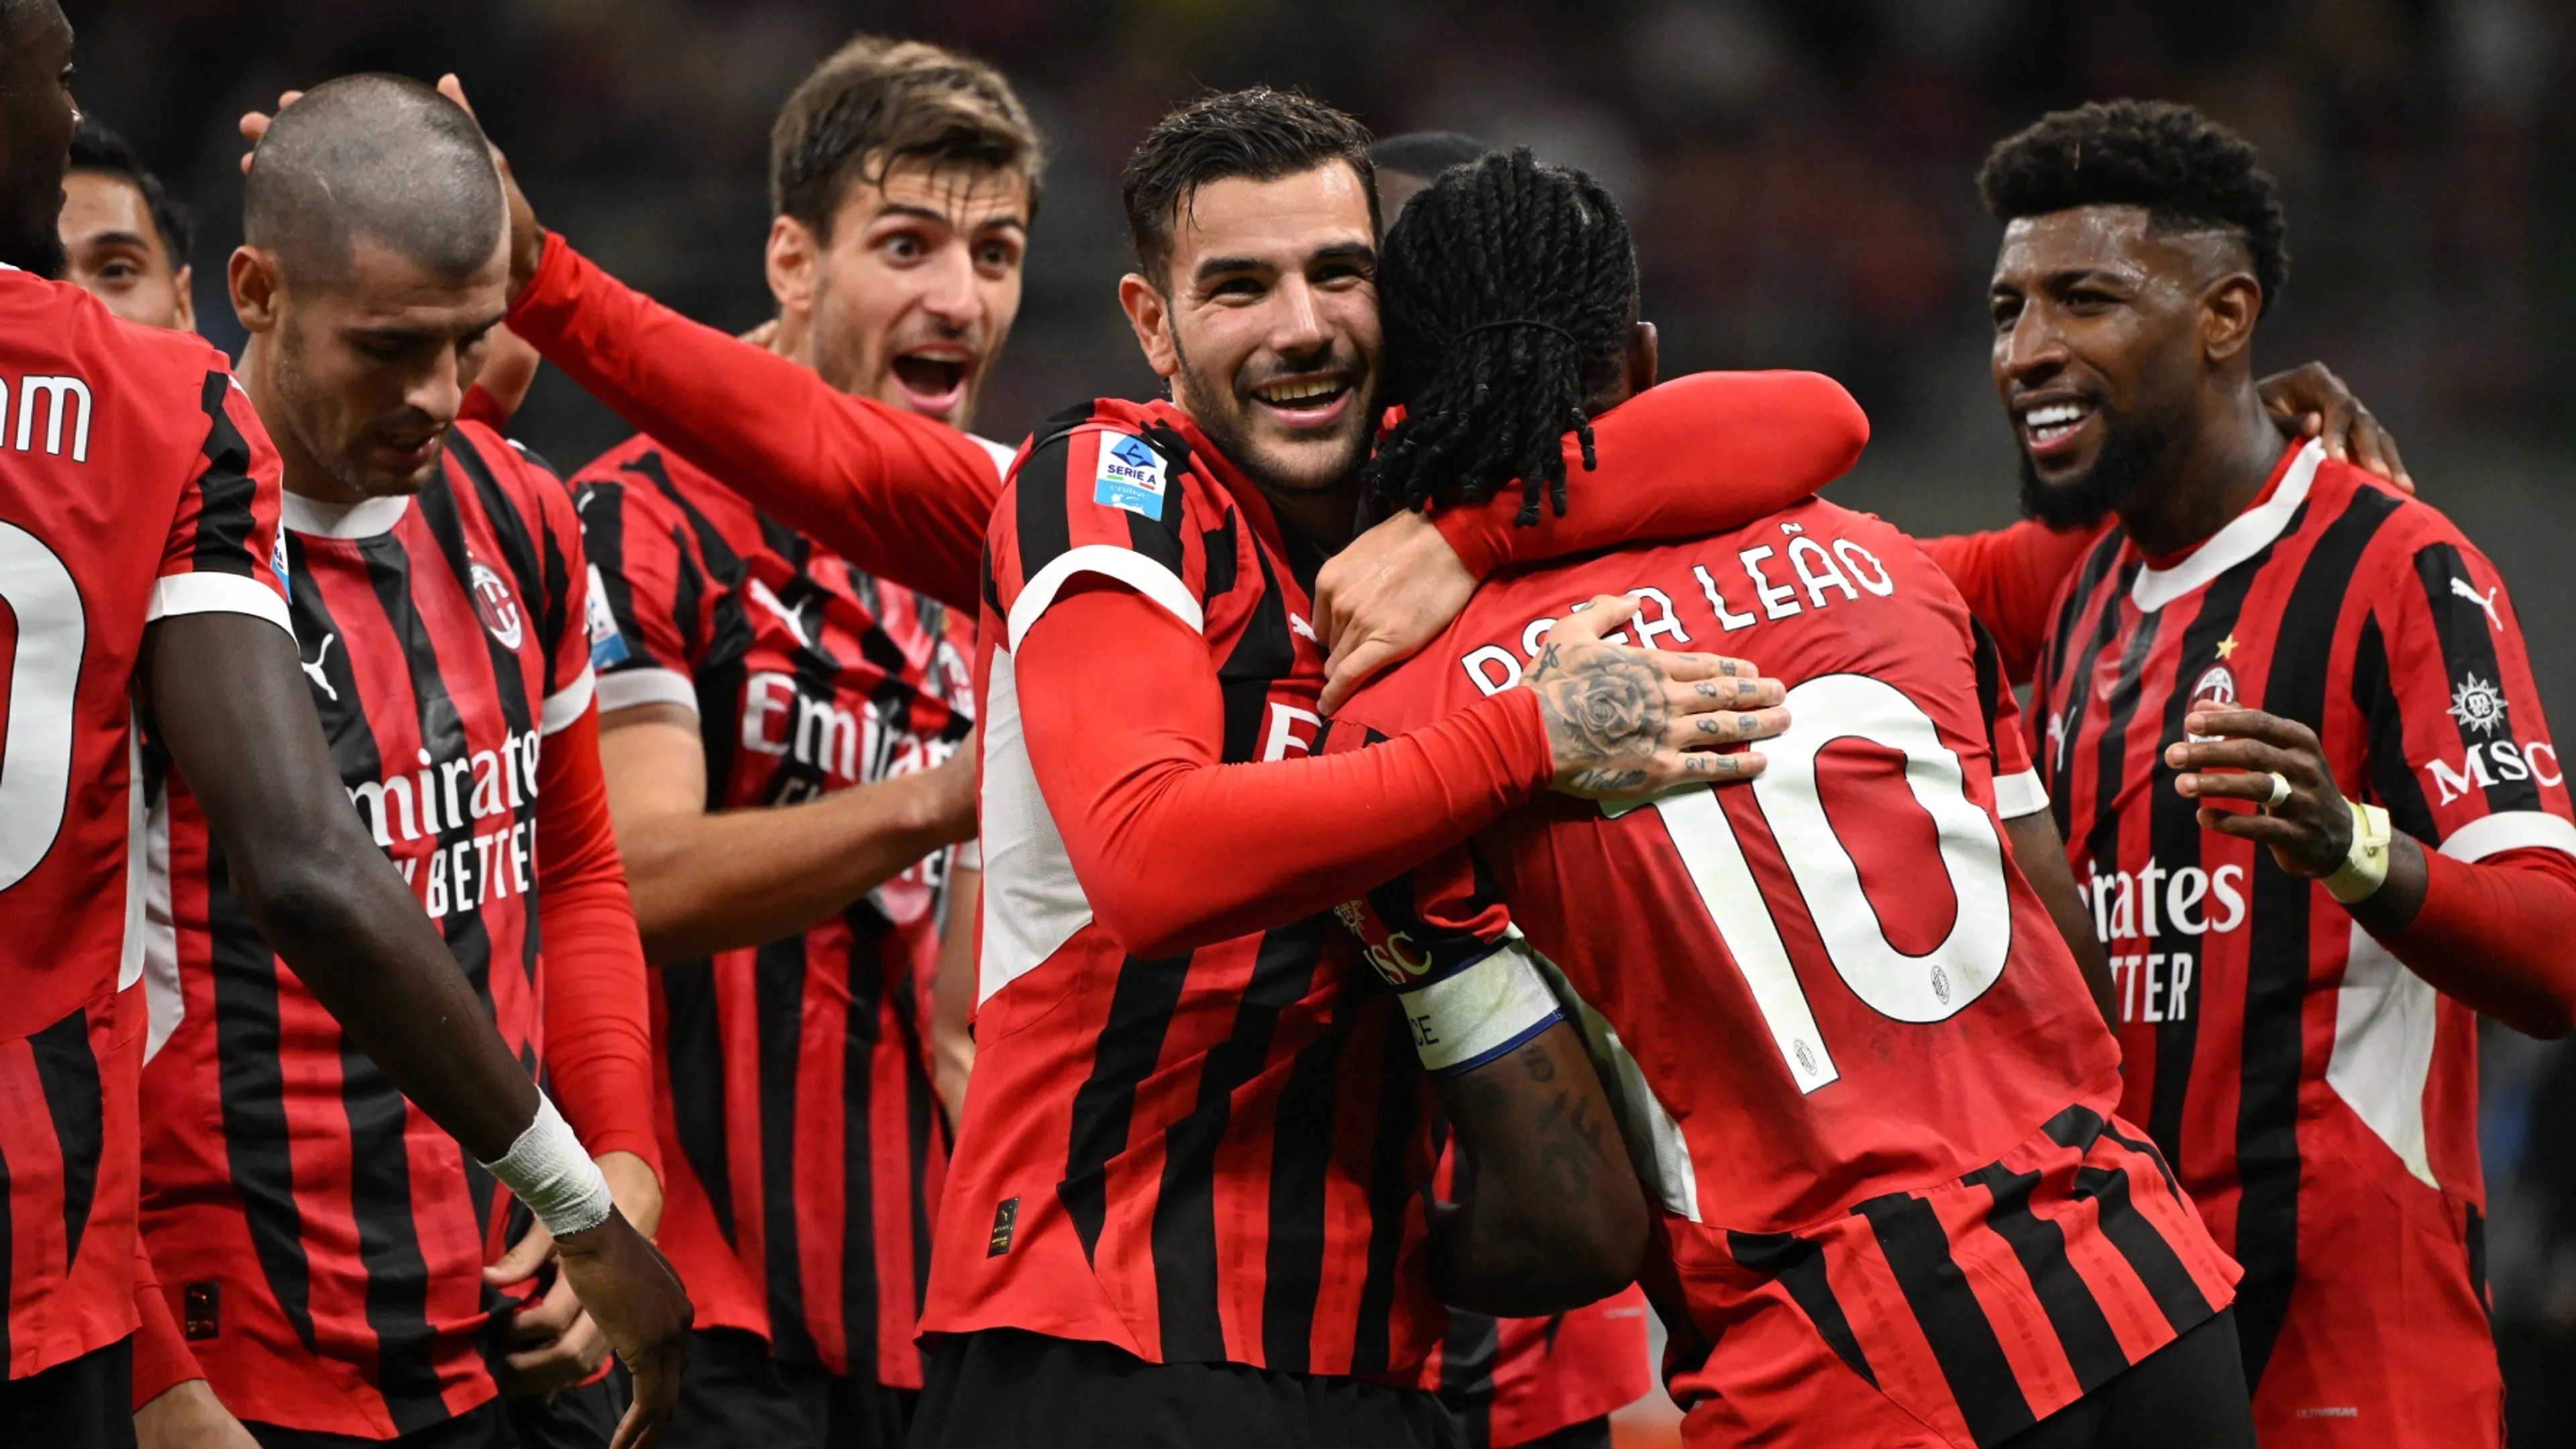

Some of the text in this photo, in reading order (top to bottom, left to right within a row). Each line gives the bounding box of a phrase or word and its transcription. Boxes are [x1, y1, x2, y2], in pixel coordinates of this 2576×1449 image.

[0, 375, 93, 463] m
[1108, 464, 1157, 485] SERIE A
[1693, 522, 1894, 633] LEÃO
[345, 727, 541, 847] mirate
[2424, 740, 2563, 807] MSC
[425, 818, 537, 919] BETTE
[1598, 672, 2012, 1095] 10
[2077, 855, 2246, 943] irates
[1362, 930, 1433, 986] SC
